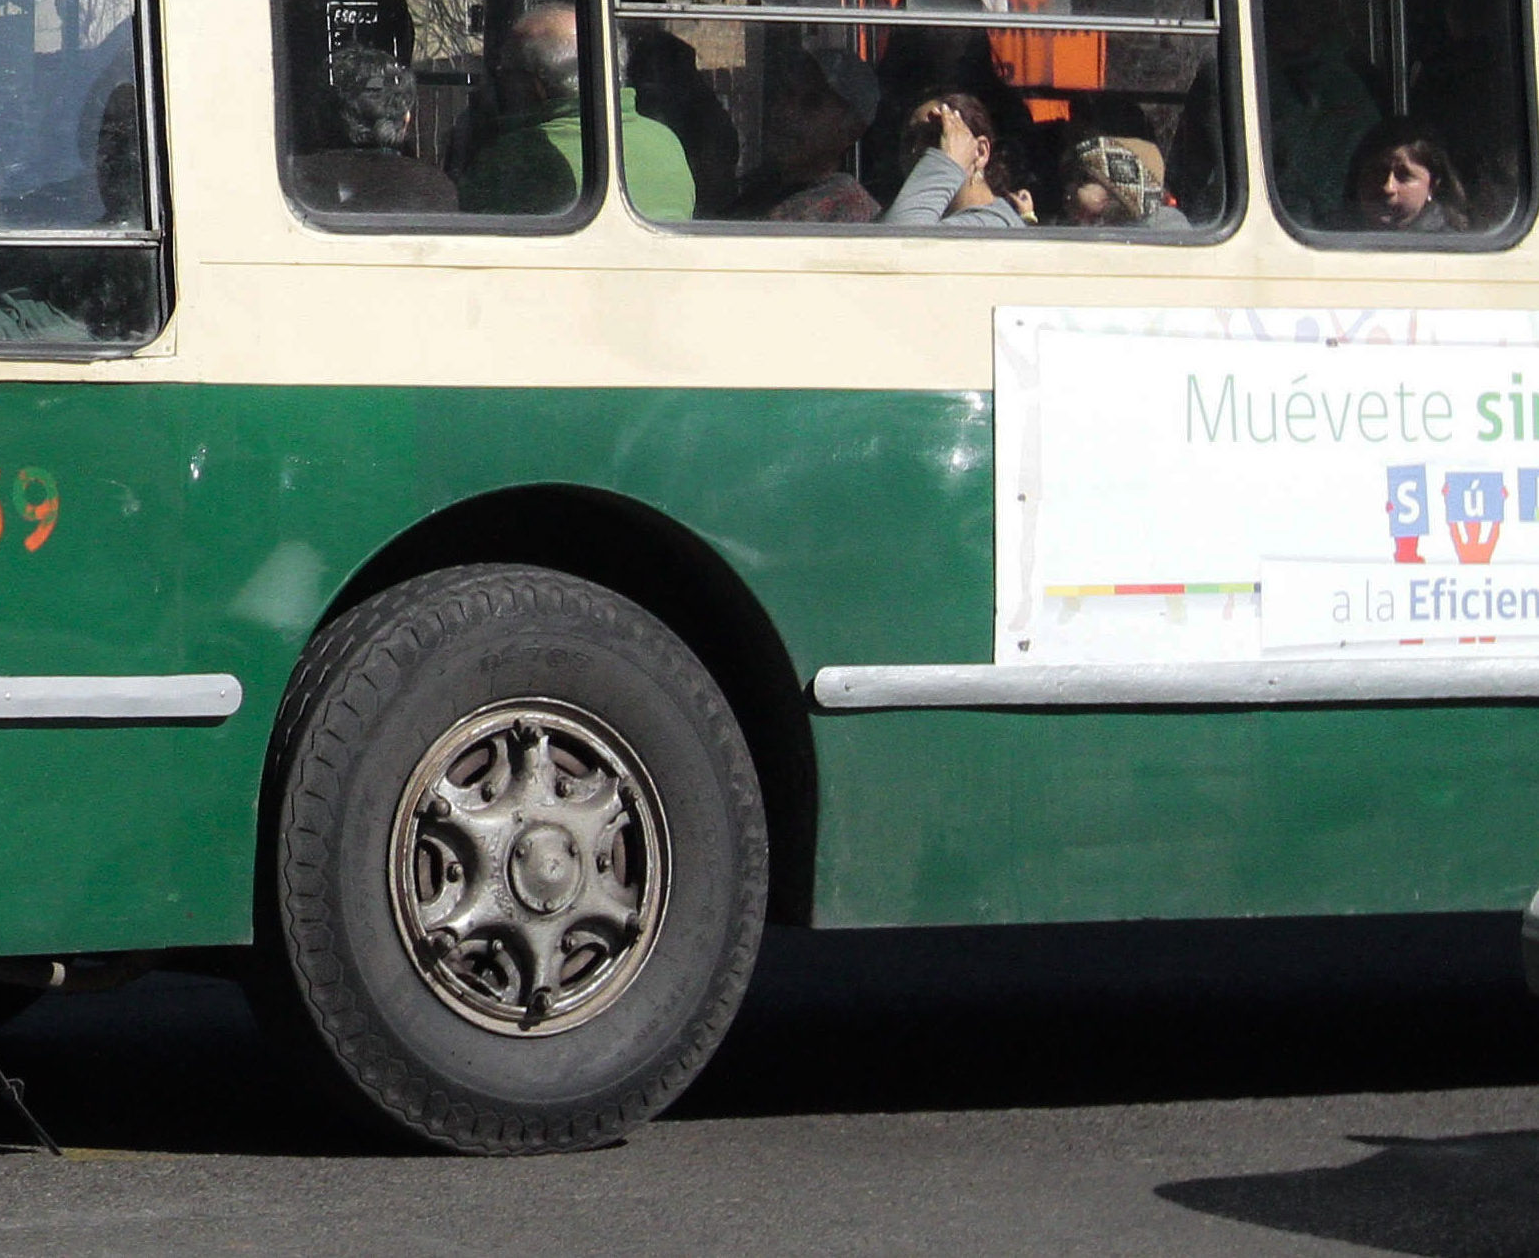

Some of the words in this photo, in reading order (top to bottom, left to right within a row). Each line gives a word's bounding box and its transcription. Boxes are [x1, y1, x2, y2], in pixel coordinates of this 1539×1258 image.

[1185, 372, 1453, 444] Muévete
[1332, 589, 1351, 623] a
[1365, 578, 1394, 623] la
